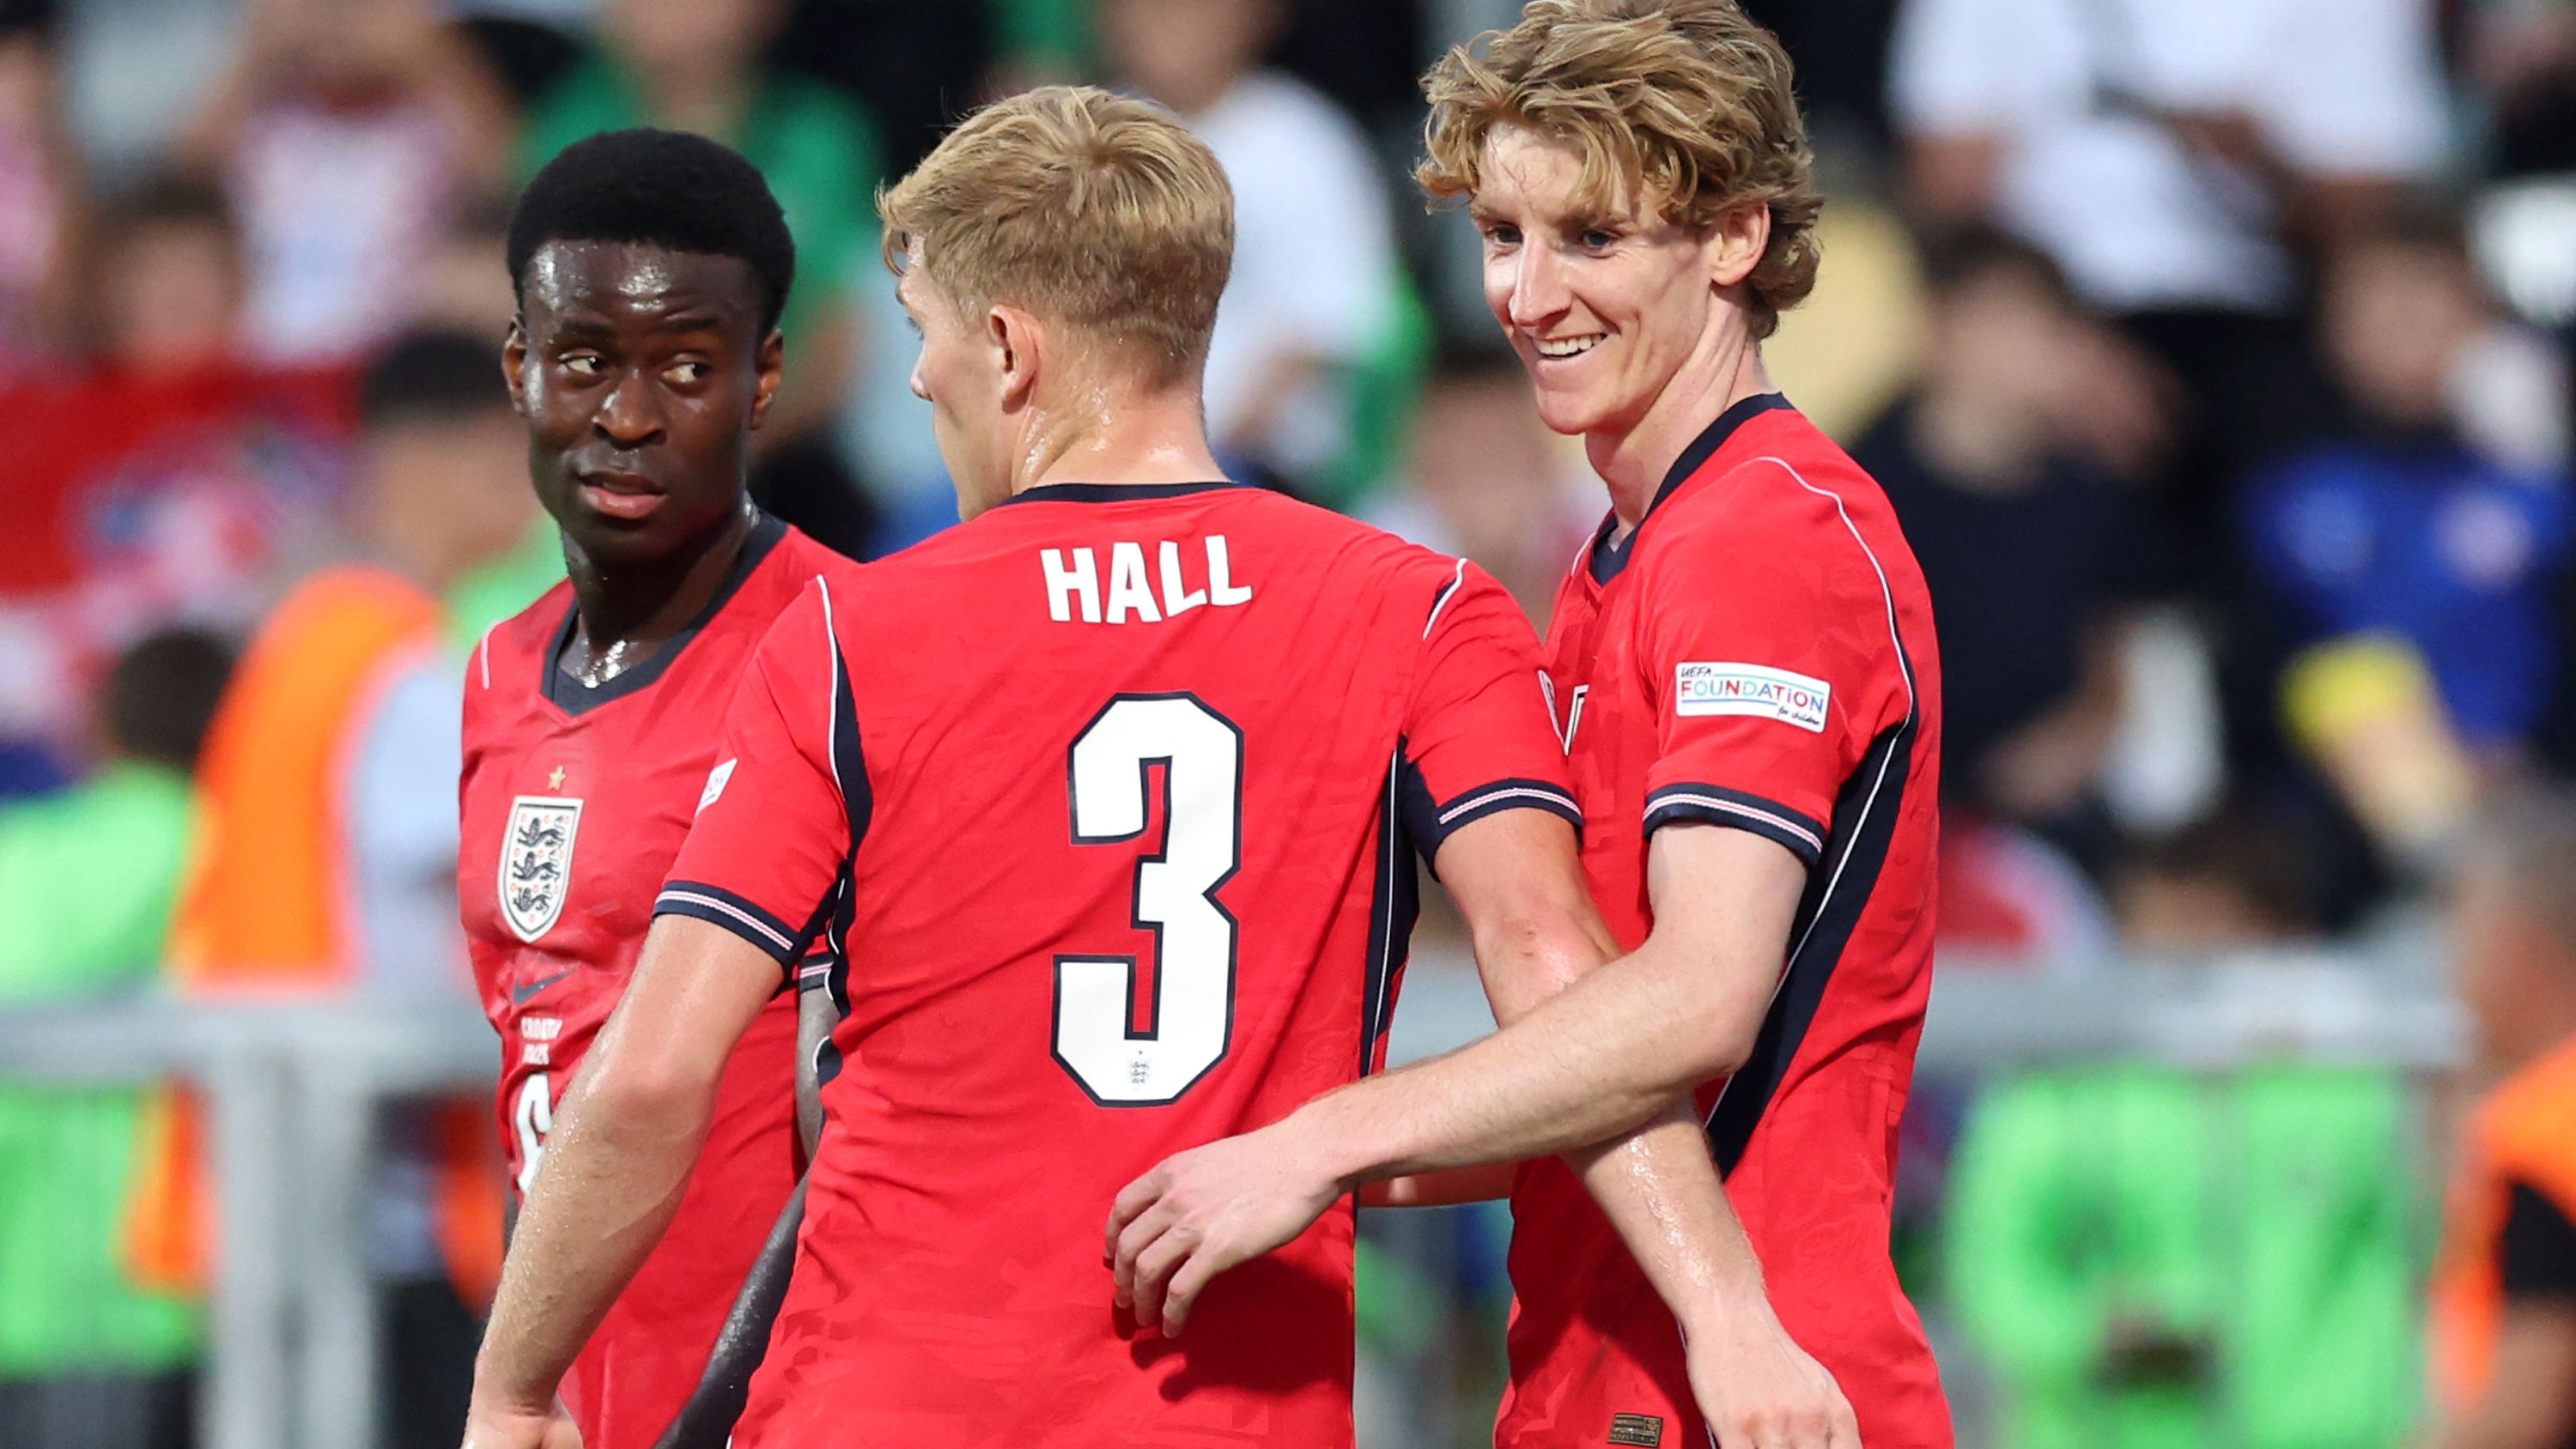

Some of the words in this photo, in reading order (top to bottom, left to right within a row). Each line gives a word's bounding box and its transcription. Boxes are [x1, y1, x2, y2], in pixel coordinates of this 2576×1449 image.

[1040, 534, 1253, 625] HALL
[1680, 666, 1712, 678] UEFA
[1680, 679, 1825, 714] FOUNDATION
[1777, 706, 1789, 717] for
[1050, 691, 1244, 1108] 3
